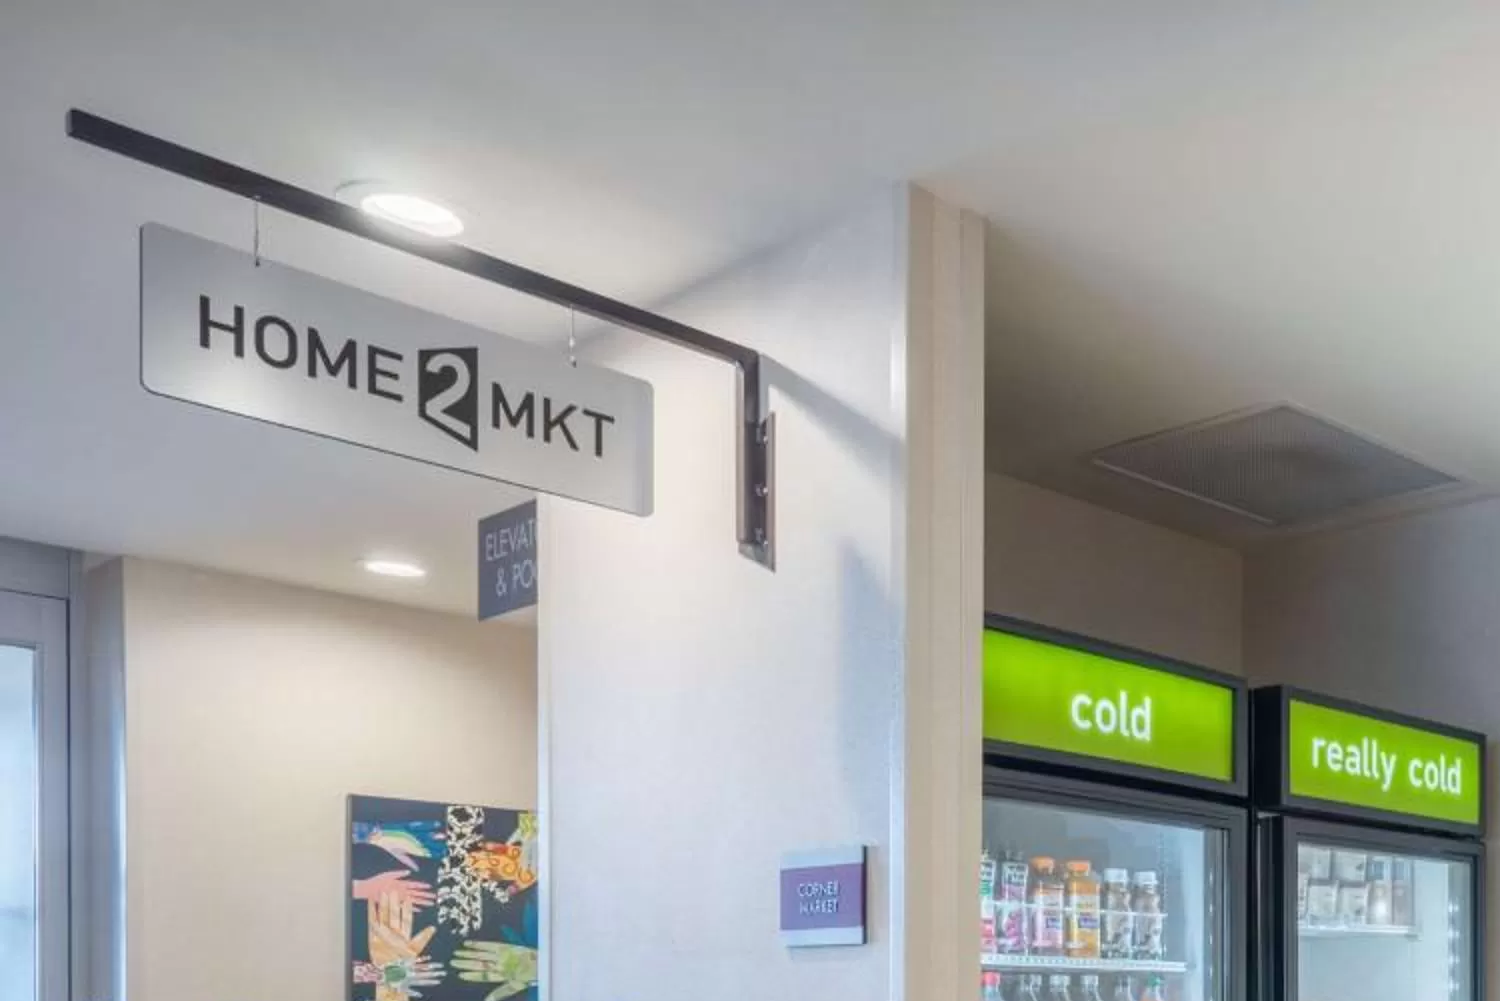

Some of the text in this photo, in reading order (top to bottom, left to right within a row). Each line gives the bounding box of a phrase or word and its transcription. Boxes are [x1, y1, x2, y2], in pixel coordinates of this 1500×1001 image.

[485, 518, 537, 562] ELEVAT
[1071, 690, 1152, 742] cold
[1311, 736, 1462, 795] really cold
